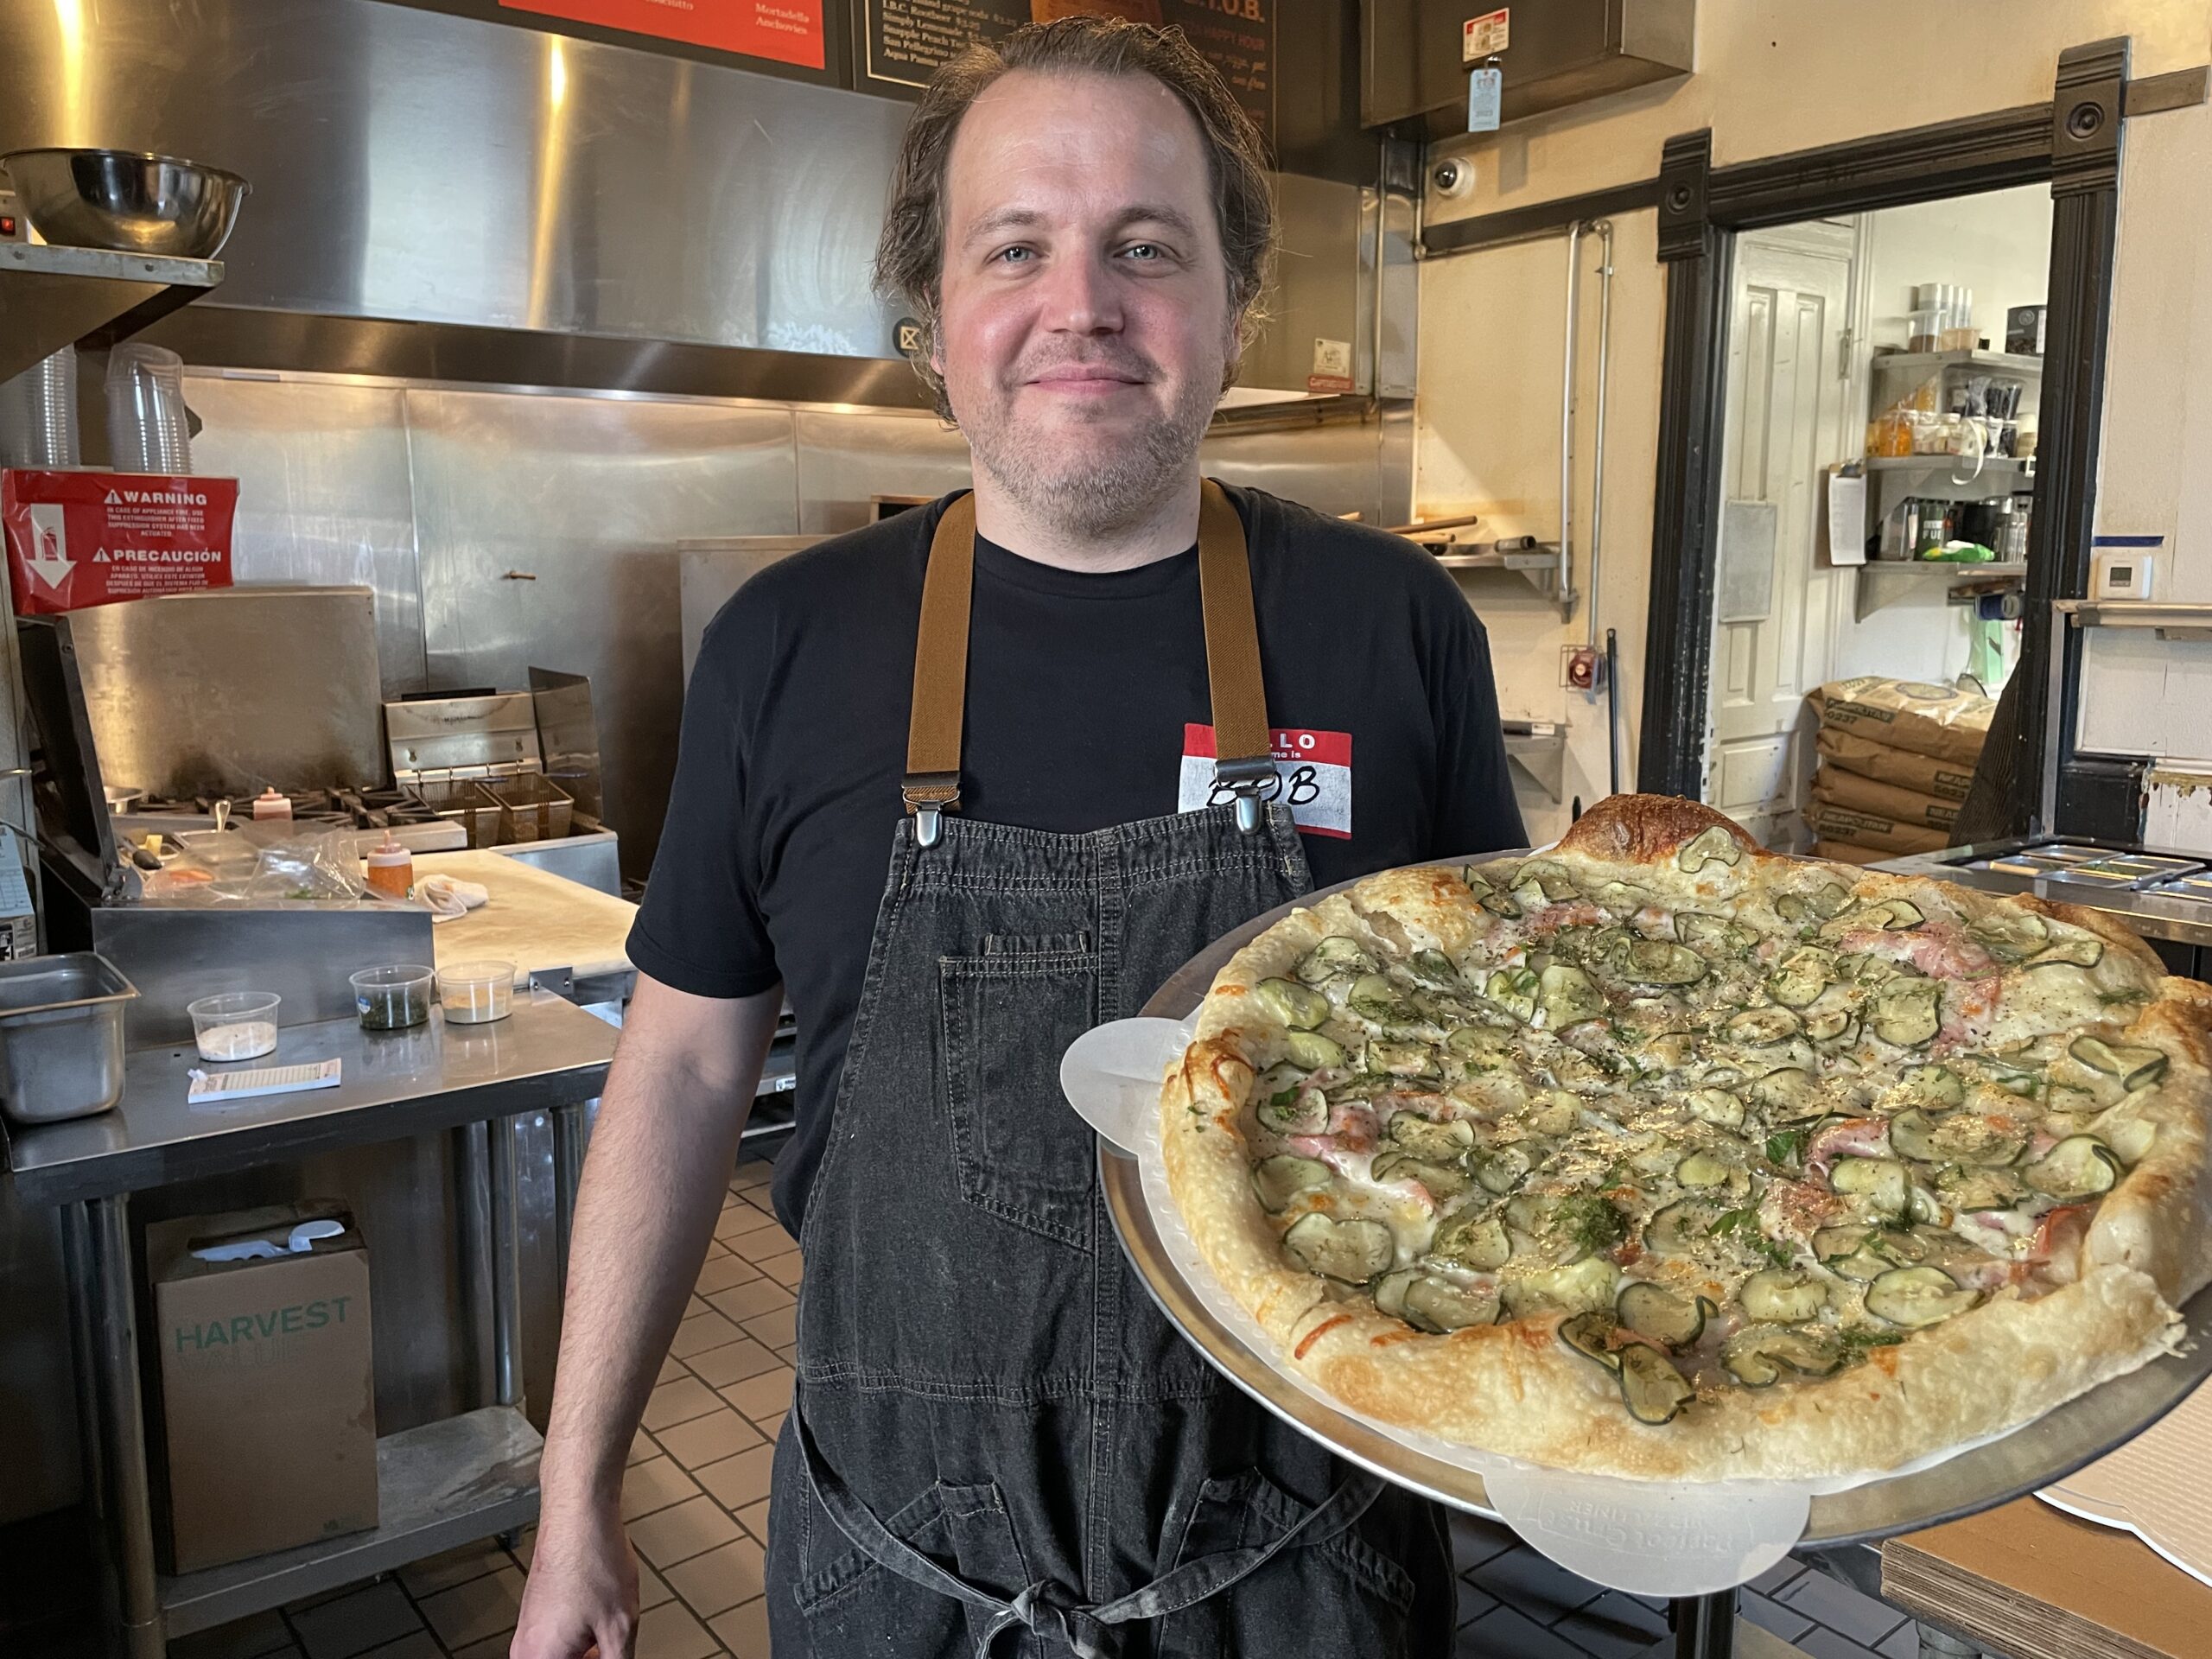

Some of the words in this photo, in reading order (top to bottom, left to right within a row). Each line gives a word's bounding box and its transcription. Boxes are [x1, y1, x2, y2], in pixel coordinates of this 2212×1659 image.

[755, 3, 810, 23] Mortadella
[755, 16, 808, 35] Anchovies
[124, 491, 207, 505] WARNING
[113, 547, 221, 563] PRECAUCIÓN
[1824, 711, 1857, 725] 0237
[1291, 750, 1301, 759] is
[175, 1297, 351, 1352] HARVEST
